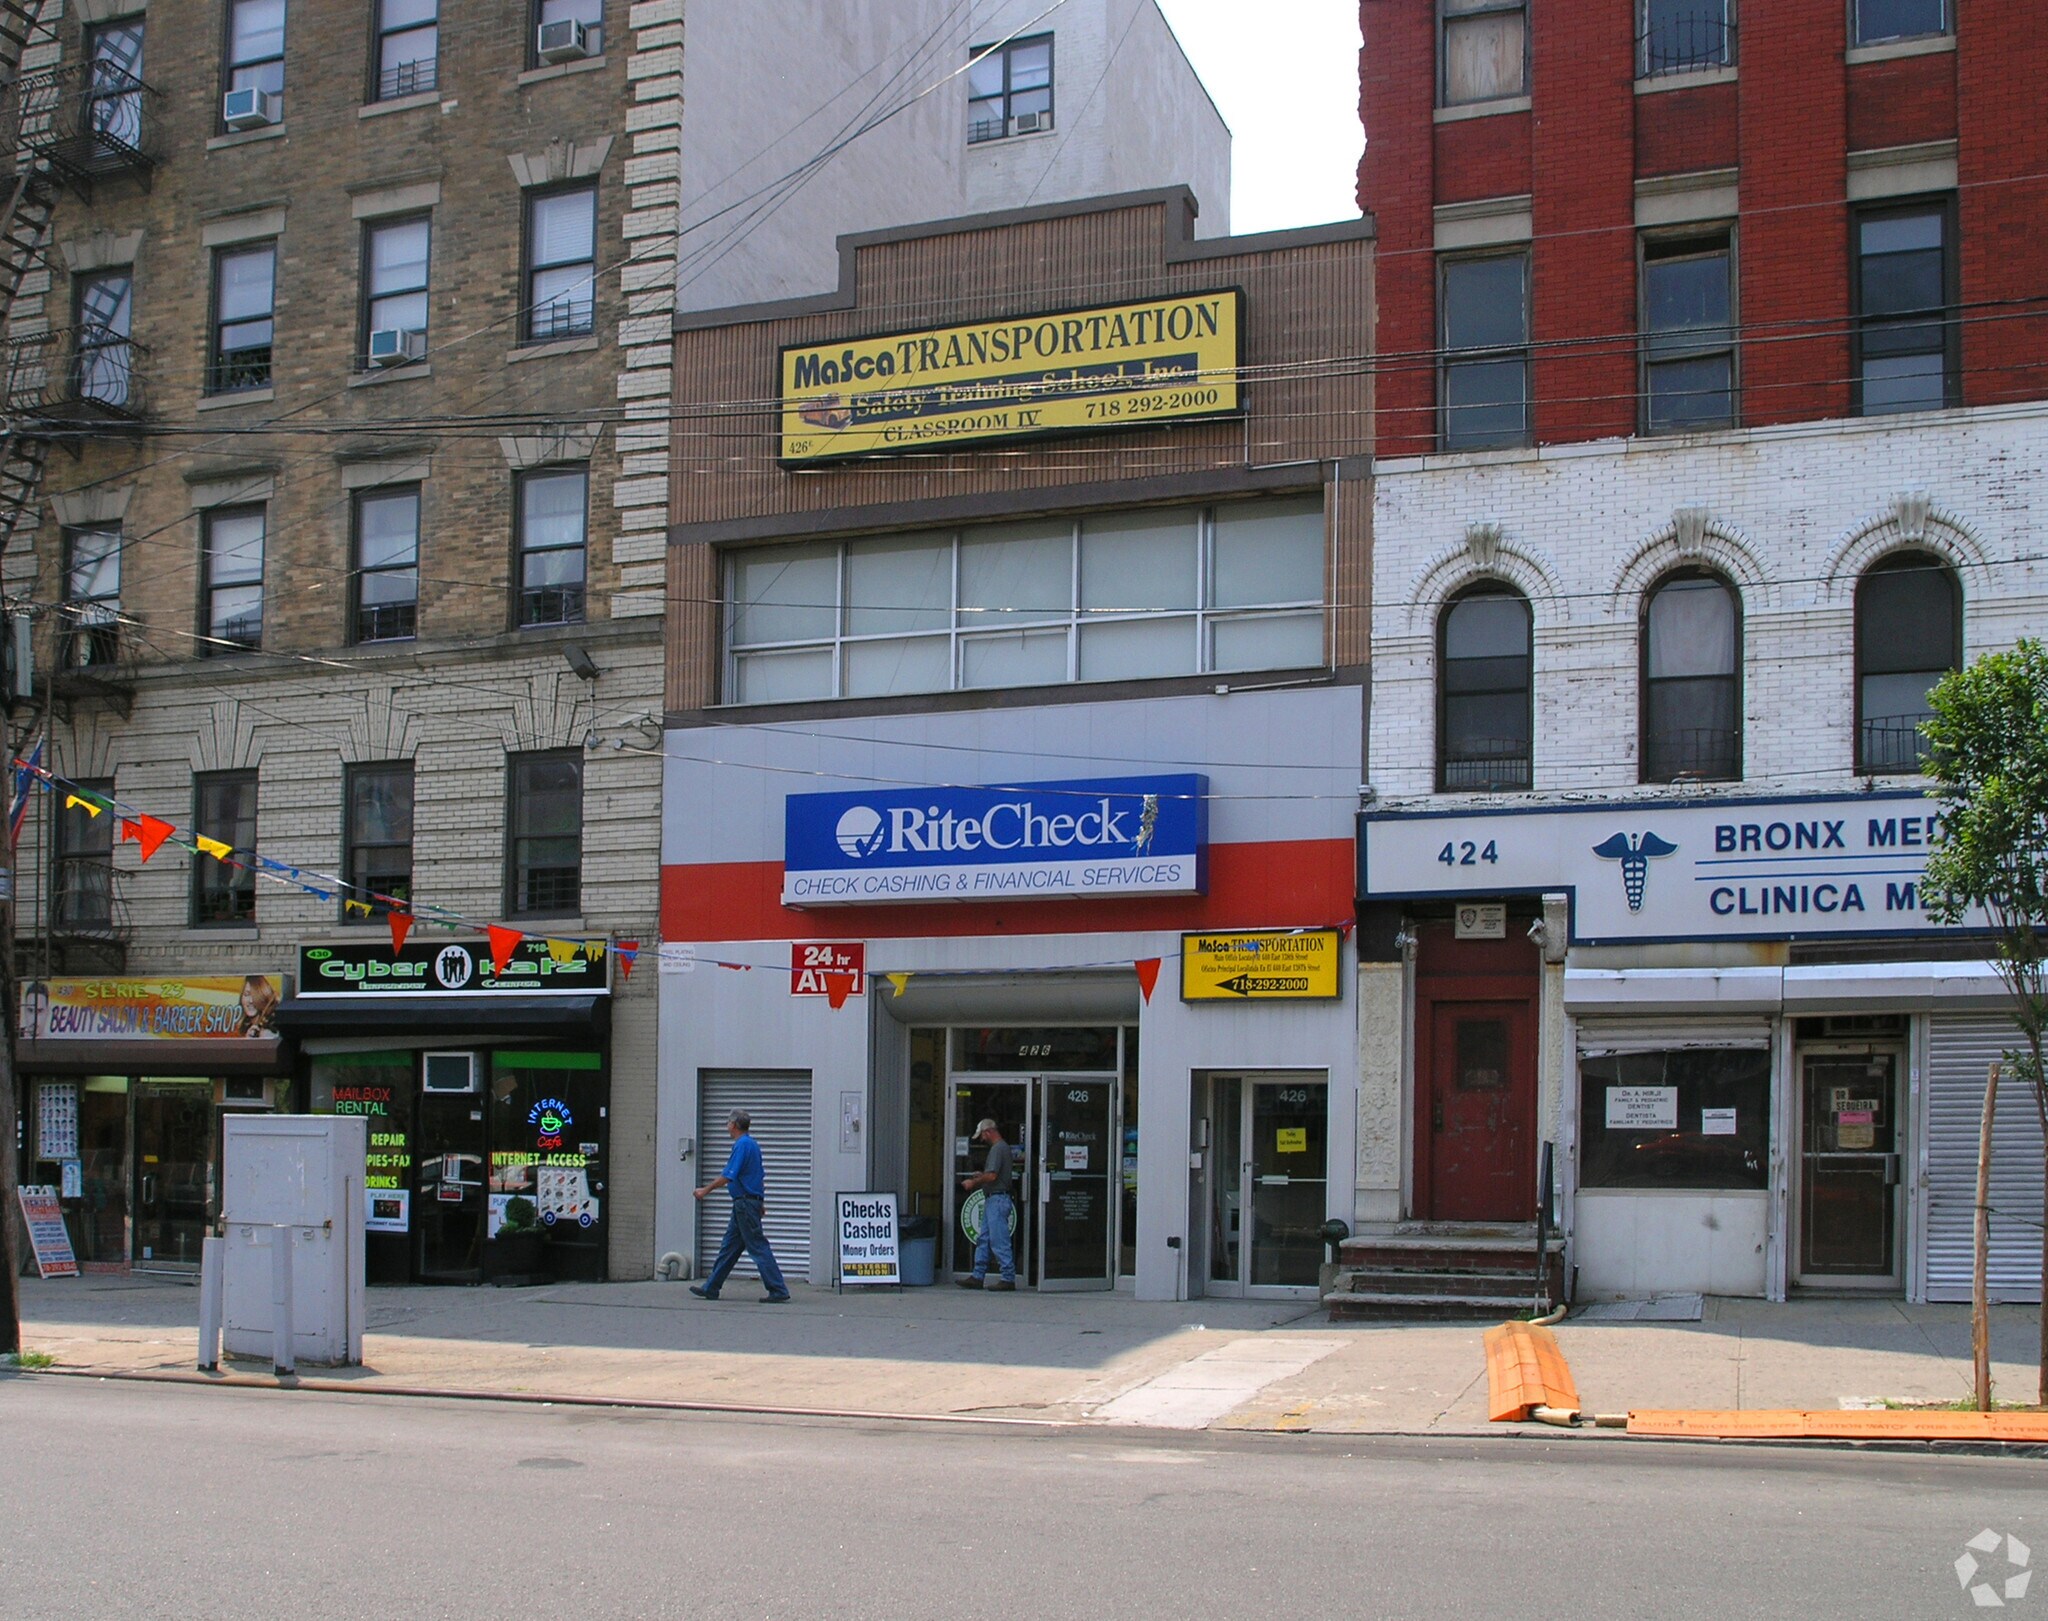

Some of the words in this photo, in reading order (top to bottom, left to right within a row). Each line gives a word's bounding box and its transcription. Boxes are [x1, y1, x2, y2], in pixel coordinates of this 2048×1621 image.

[793, 349, 896, 390] MaSca
[897, 301, 1220, 375] TRANSPORTATION
[856, 390, 927, 417] Safety
[938, 378, 1033, 406] Training
[1085, 402, 1121, 419] 718
[1127, 388, 1219, 415] 292-2000
[883, 413, 1009, 443] CLASSROOM
[1017, 409, 1041, 428] IV
[886, 798, 1133, 853] RiteCheck
[1715, 819, 1846, 853] BRONX
[1438, 840, 1499, 867] 424
[793, 876, 861, 897] CHECK
[863, 873, 952, 895] CASHING
[955, 872, 969, 890] &
[974, 869, 1075, 889] FINANCIAL
[1080, 863, 1182, 886] SERVICES
[1710, 882, 1866, 916] CLINICA
[804, 946, 834, 966] 24
[836, 953, 851, 965] hr
[320, 959, 428, 980] Cyber
[85, 982, 149, 999] SERIE
[160, 983, 186, 999] 23
[1232, 978, 1308, 990] 718-292-2000
[50, 1005, 97, 1033] BEAUTY
[97, 1005, 140, 1033] SALON
[140, 1005, 149, 1033] &
[153, 1005, 202, 1033] BARBER
[205, 1004, 243, 1033] SHOP
[1019, 1045, 1051, 1056] 426
[332, 1086, 391, 1101] MAILBOX
[1068, 1090, 1088, 1103] 426
[1280, 1090, 1306, 1102] 426
[335, 1101, 388, 1115] RENTAL
[528, 1098, 573, 1126] INTERNET
[371, 1133, 405, 1146] REPAIR
[365, 1154, 411, 1167] PIES-FAX
[492, 1152, 541, 1167] INTERNET
[546, 1153, 587, 1167] ACCESS
[842, 1200, 891, 1218] Checks
[843, 1221, 891, 1239] Cashed
[842, 1244, 867, 1257] Money
[869, 1244, 895, 1256] Orders
